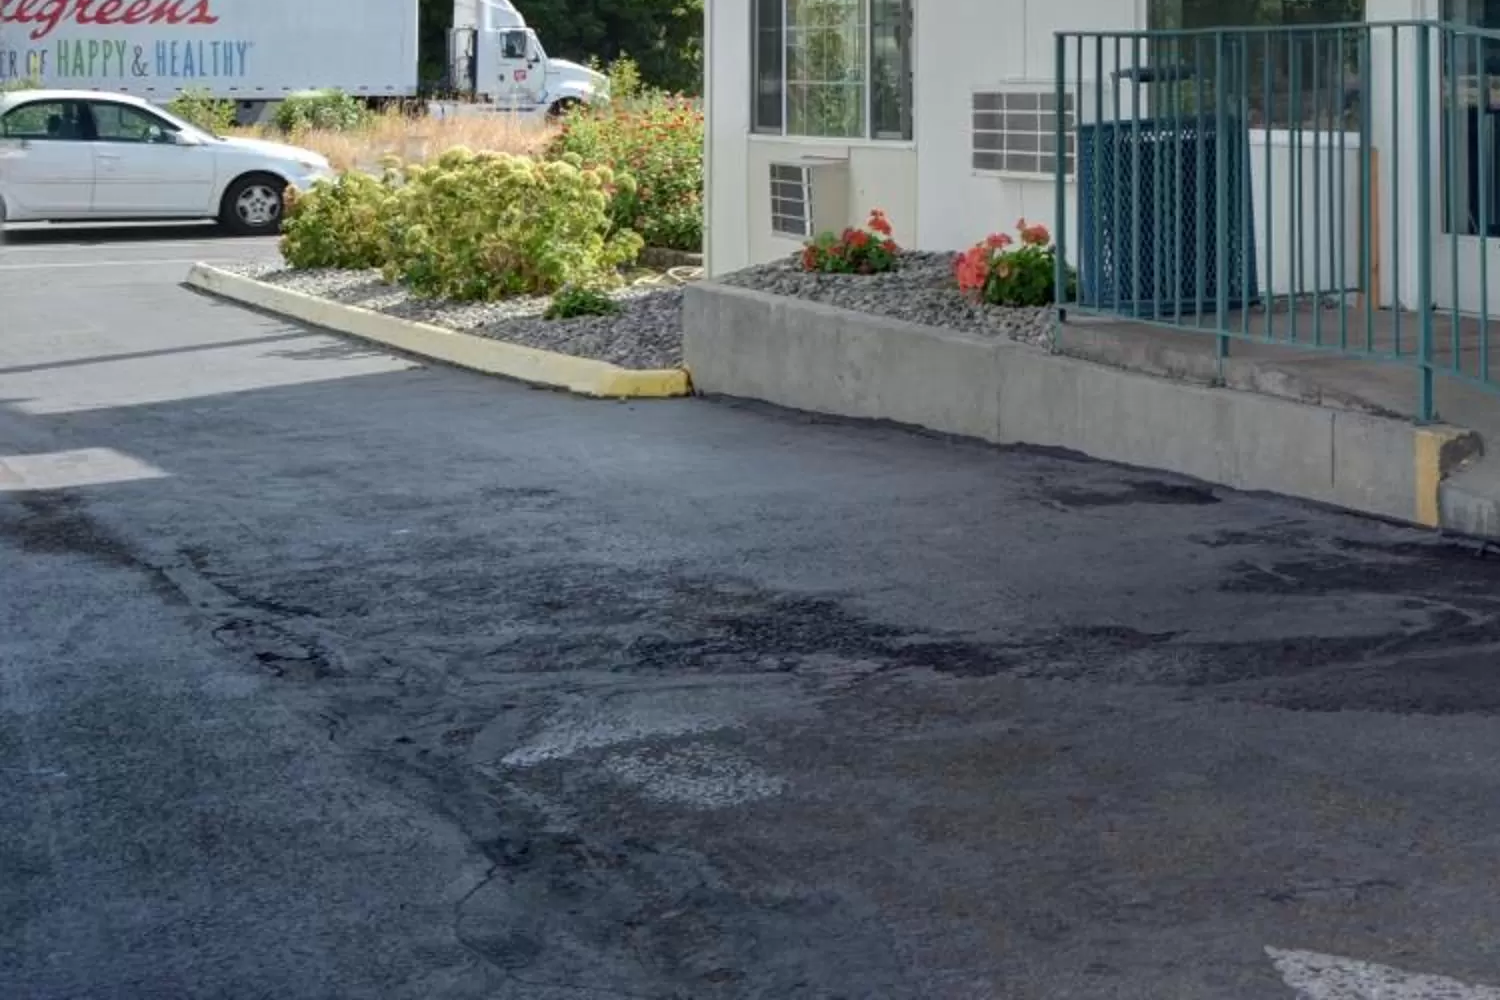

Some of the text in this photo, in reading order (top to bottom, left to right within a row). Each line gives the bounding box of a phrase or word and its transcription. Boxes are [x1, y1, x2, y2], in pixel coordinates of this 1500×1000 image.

[57, 39, 127, 78] HAPPY
[131, 45, 149, 77] &
[156, 39, 247, 77] HEALTHY
